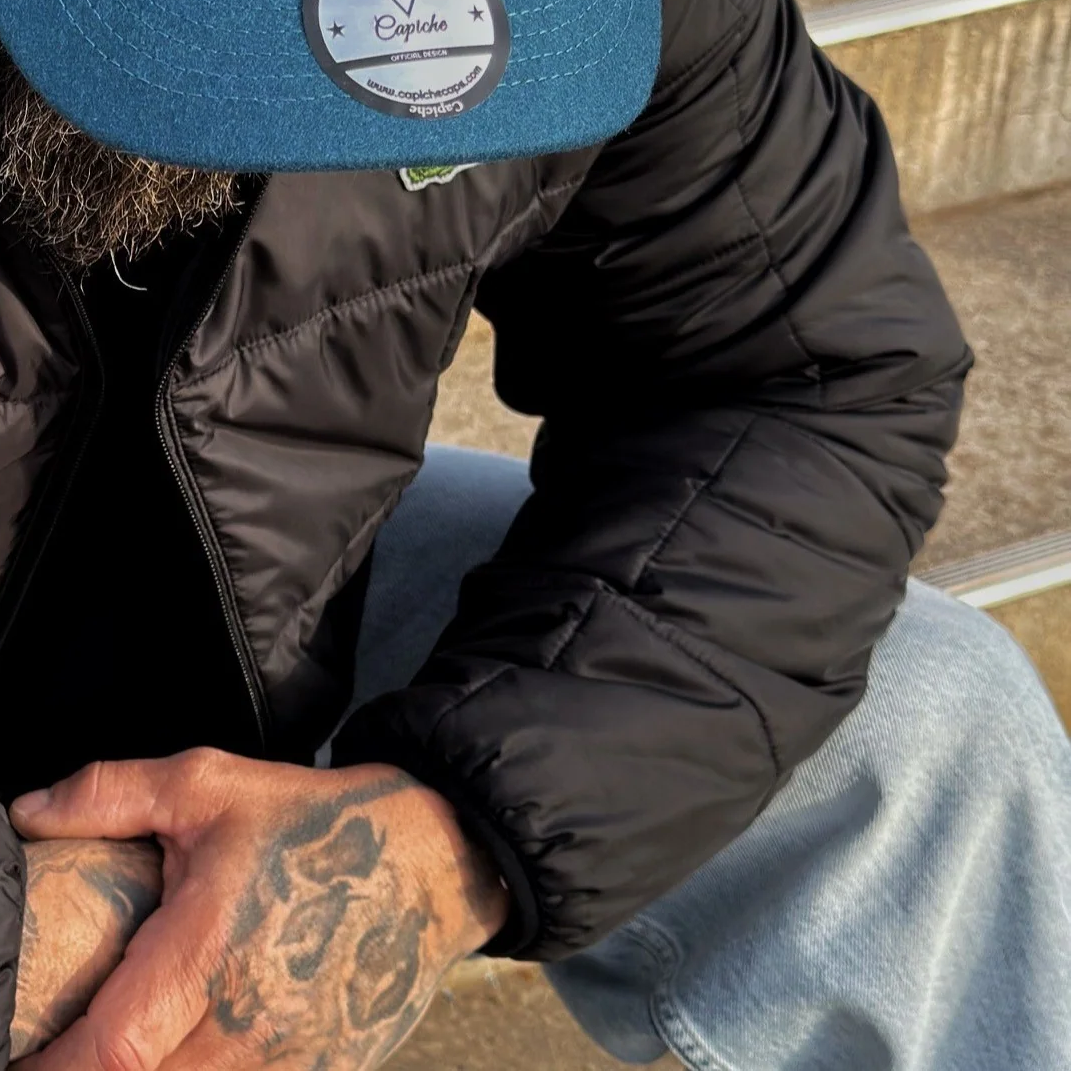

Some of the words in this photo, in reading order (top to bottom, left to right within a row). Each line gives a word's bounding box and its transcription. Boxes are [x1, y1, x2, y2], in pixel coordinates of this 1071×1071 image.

[374, 13, 448, 43] Capiche
[390, 51, 422, 62] OFFICIAL
[423, 49, 448, 59] DESIGN
[366, 65, 482, 102] www.capichecaps.com
[409, 101, 464, 118] Capiche
